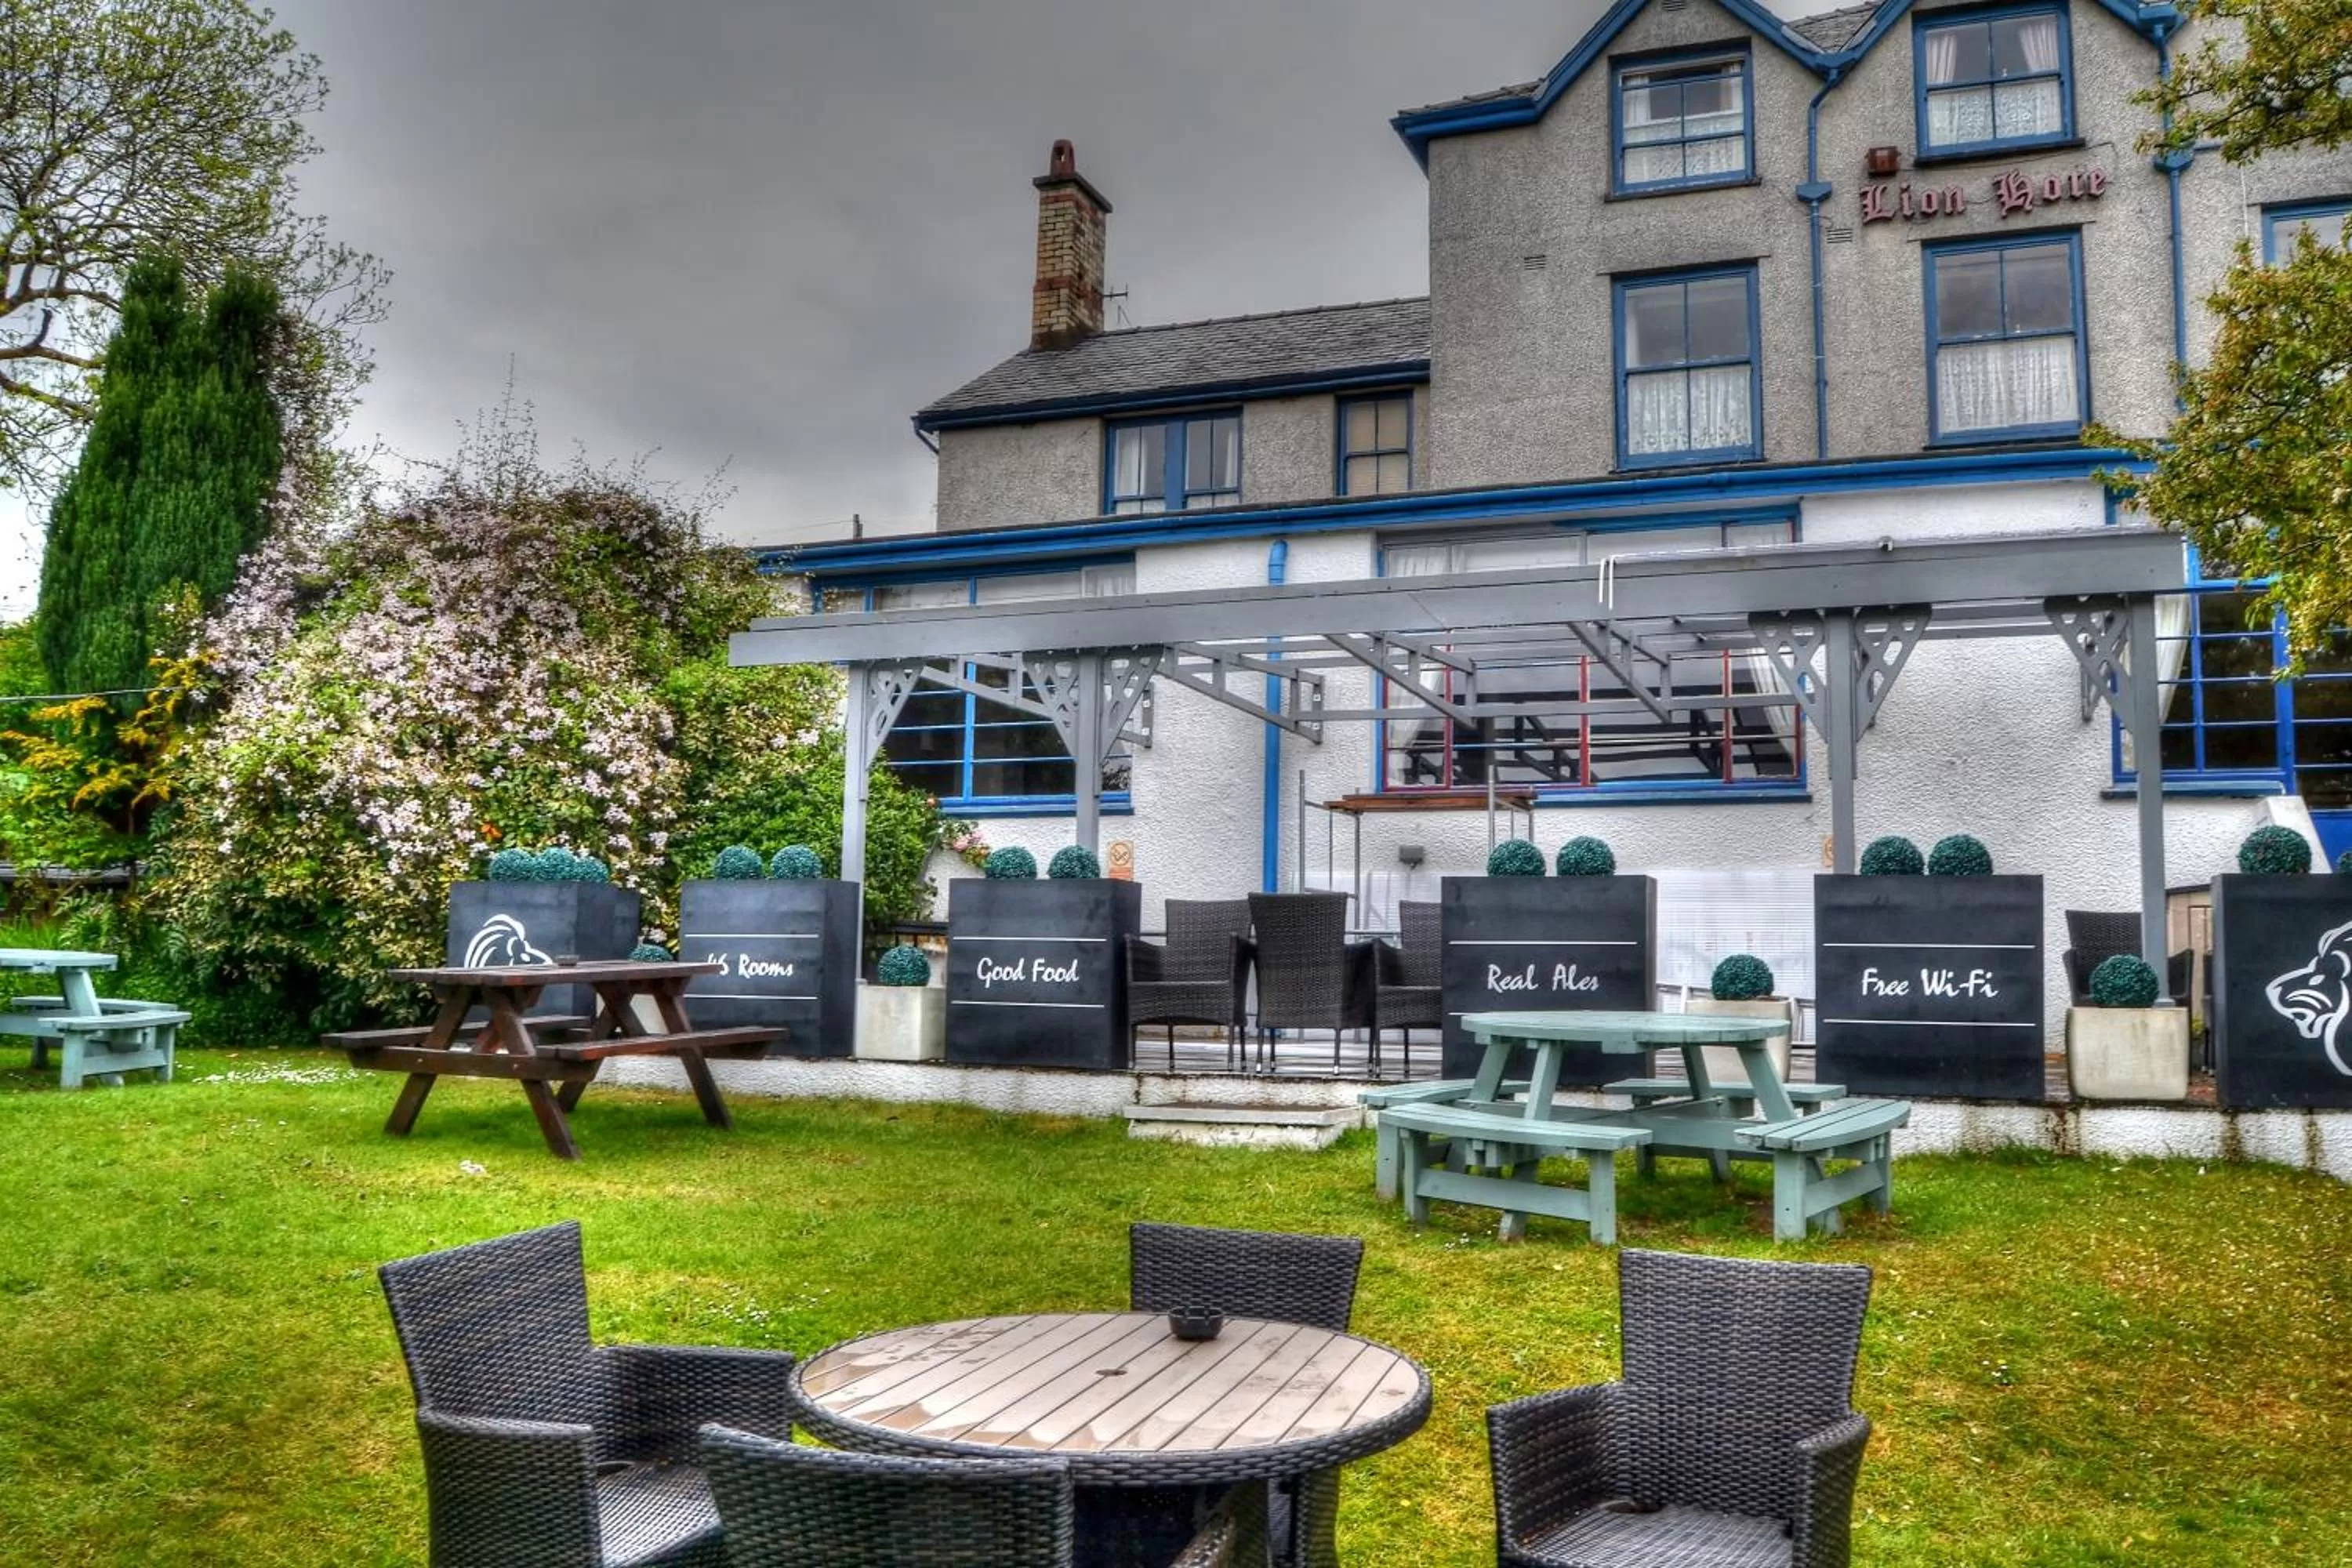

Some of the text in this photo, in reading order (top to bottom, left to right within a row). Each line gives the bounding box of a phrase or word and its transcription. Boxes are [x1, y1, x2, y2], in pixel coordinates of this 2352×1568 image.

[1860, 165, 2107, 225] Lion Hote
[738, 953, 793, 978] Rooms
[977, 956, 1080, 989] Good Food
[1487, 963, 1599, 993] Real Ales
[1861, 967, 1998, 997] Free Wi-Fi
